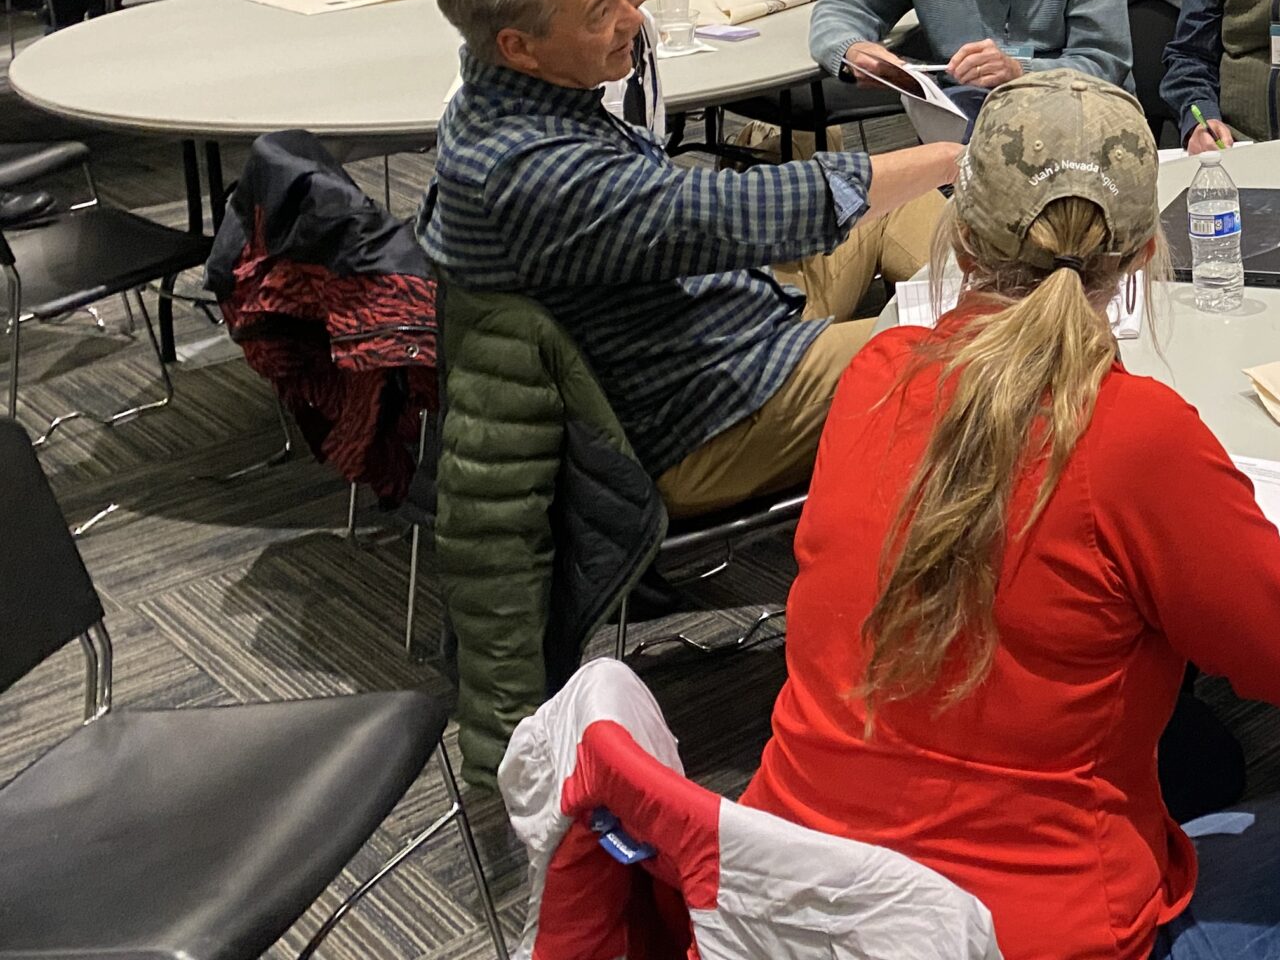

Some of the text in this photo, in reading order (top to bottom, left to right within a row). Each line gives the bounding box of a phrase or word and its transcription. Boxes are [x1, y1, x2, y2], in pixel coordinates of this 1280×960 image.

[1028, 166, 1054, 186] Utah
[1061, 159, 1100, 173] Nevada
[1100, 166, 1120, 196] gion
